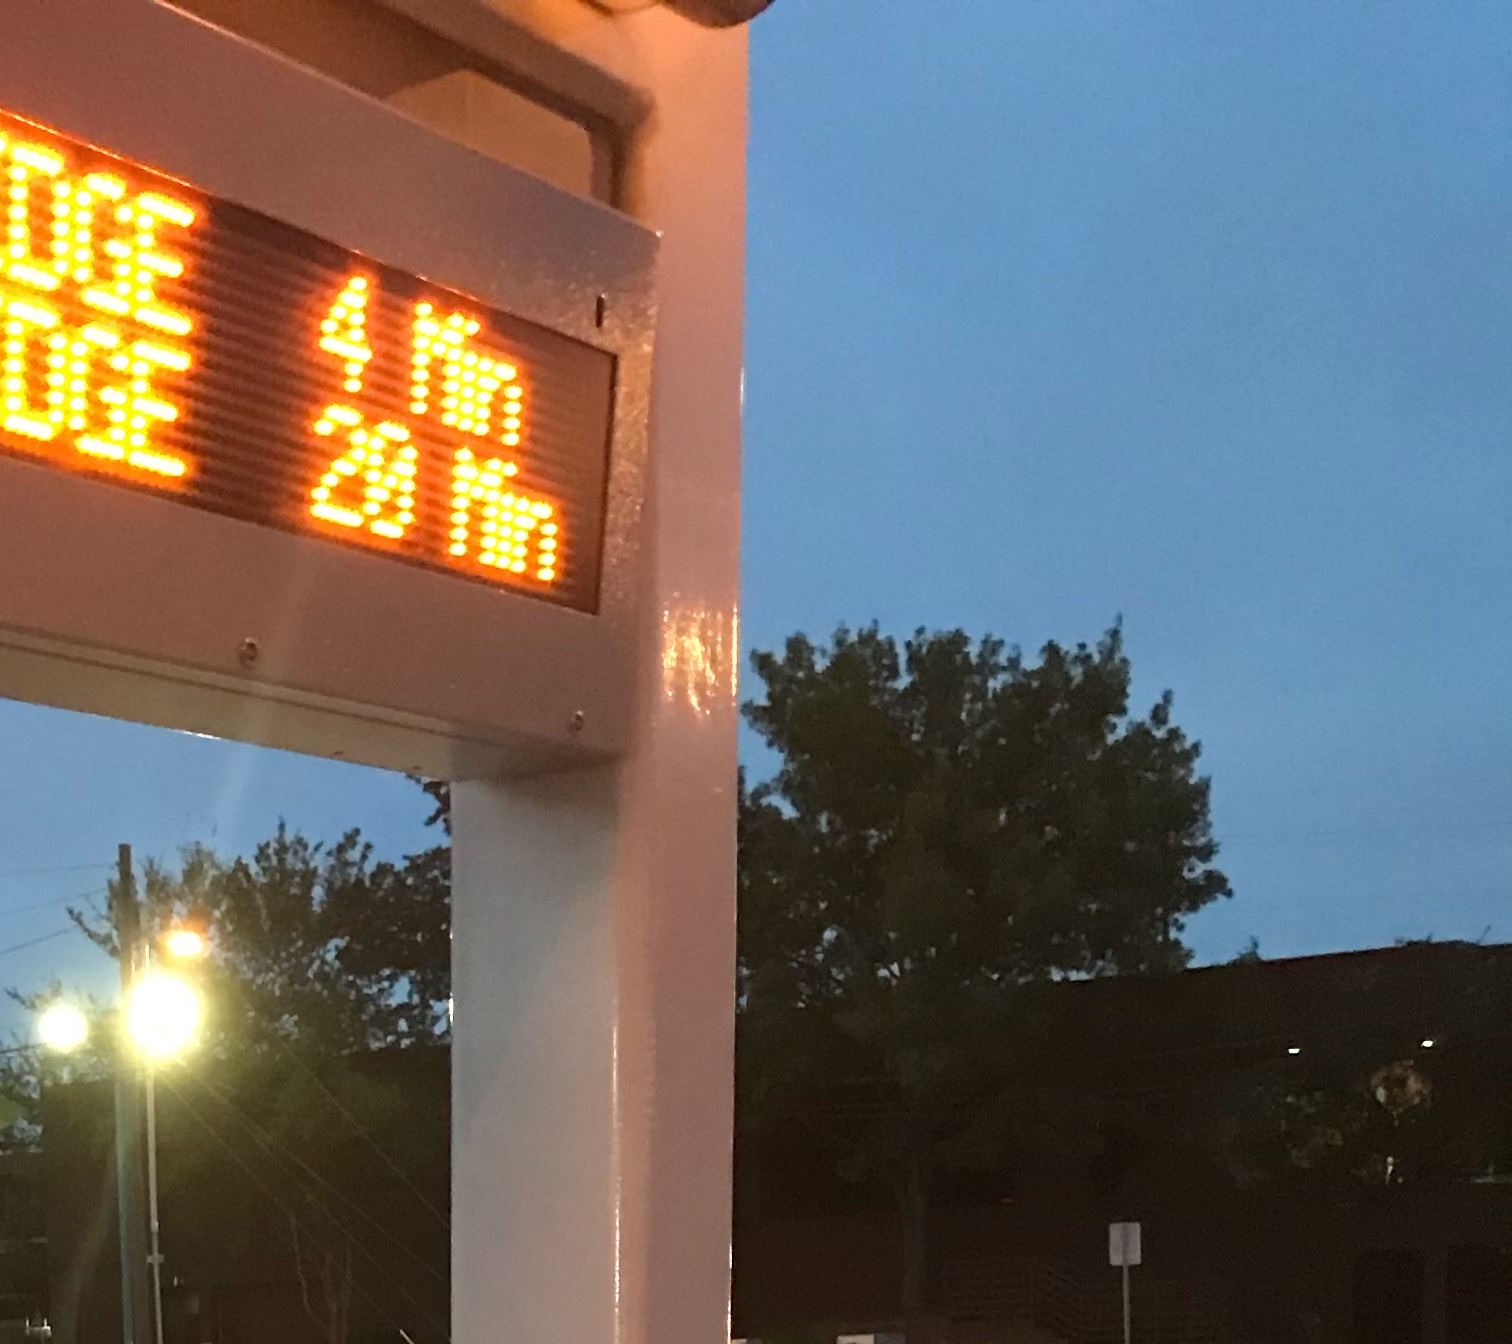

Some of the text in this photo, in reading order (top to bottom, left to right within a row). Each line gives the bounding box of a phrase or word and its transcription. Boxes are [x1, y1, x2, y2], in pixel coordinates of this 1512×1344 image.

[317, 272, 373, 395] 4
[408, 299, 526, 448] Min
[448, 445, 561, 583] Min
